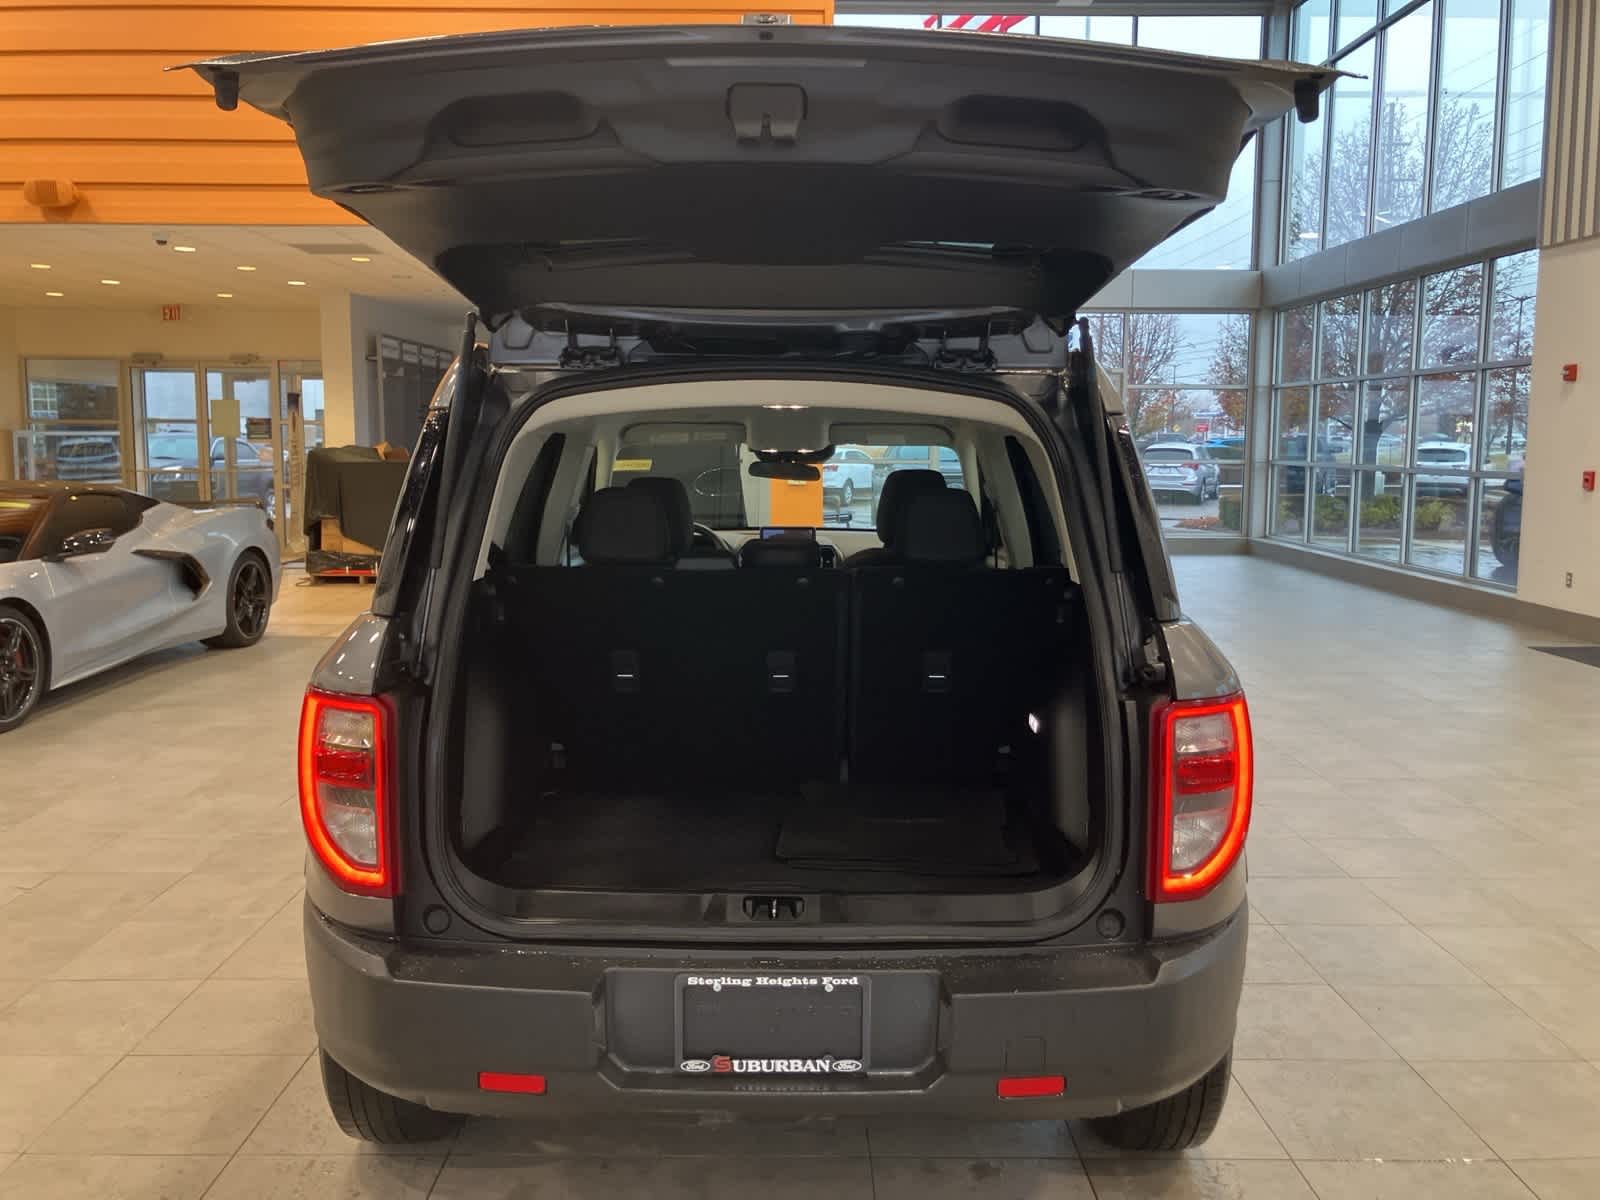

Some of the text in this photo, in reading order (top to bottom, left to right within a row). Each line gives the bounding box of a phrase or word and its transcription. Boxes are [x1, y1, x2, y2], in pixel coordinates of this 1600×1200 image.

[161, 304, 182, 320] EXIT
[687, 976, 858, 987] Sterling Heights Ford
[683, 1060, 708, 1072] Ford
[713, 1056, 830, 1073] SUBURBAN
[835, 1060, 860, 1072] Ford
